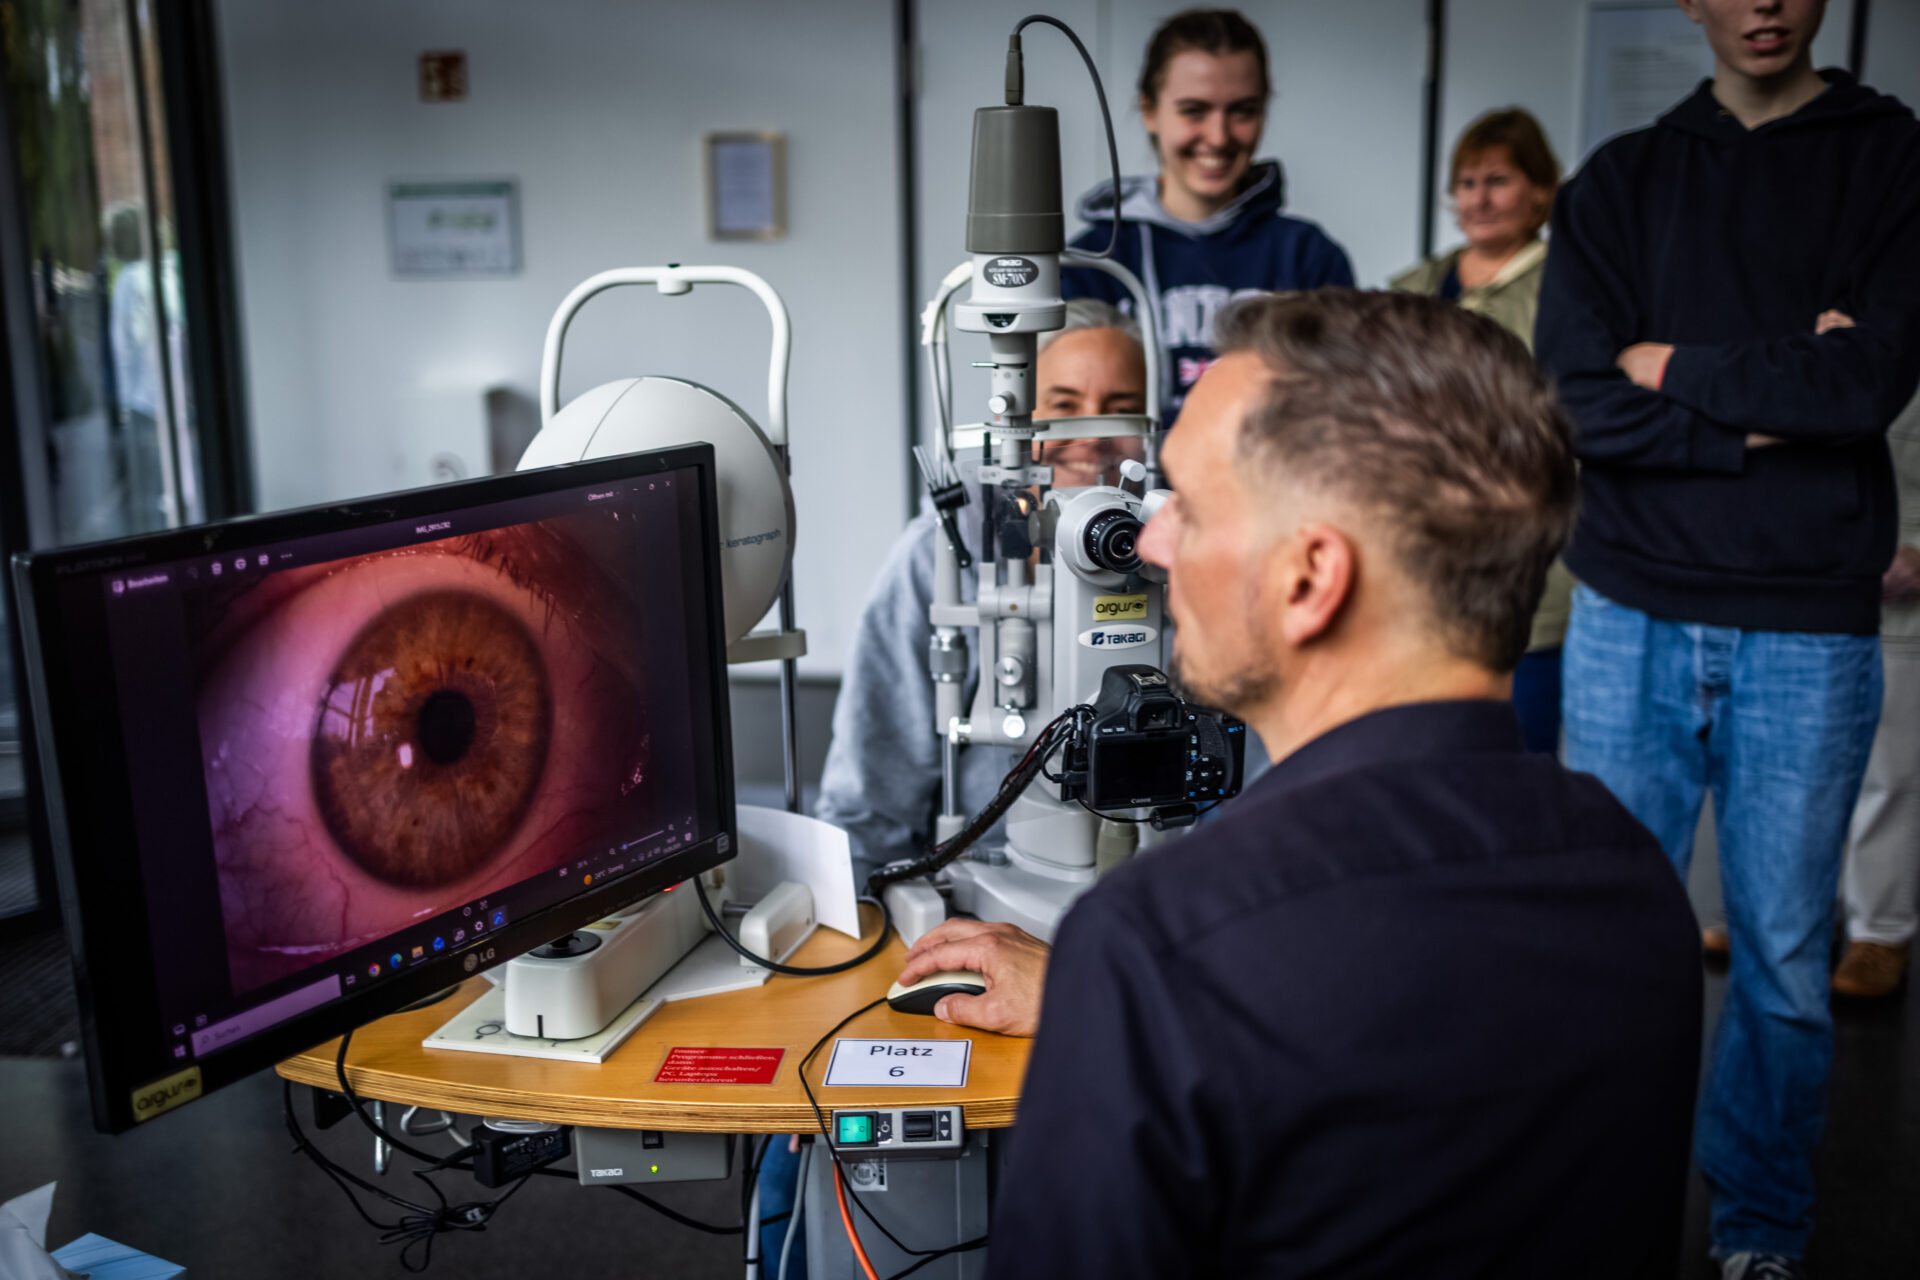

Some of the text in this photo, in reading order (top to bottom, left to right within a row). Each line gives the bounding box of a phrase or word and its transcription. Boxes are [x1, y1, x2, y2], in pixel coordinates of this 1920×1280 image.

[479, 947, 496, 964] LG
[869, 1045, 934, 1057] Platz
[888, 1066, 905, 1078] 6
